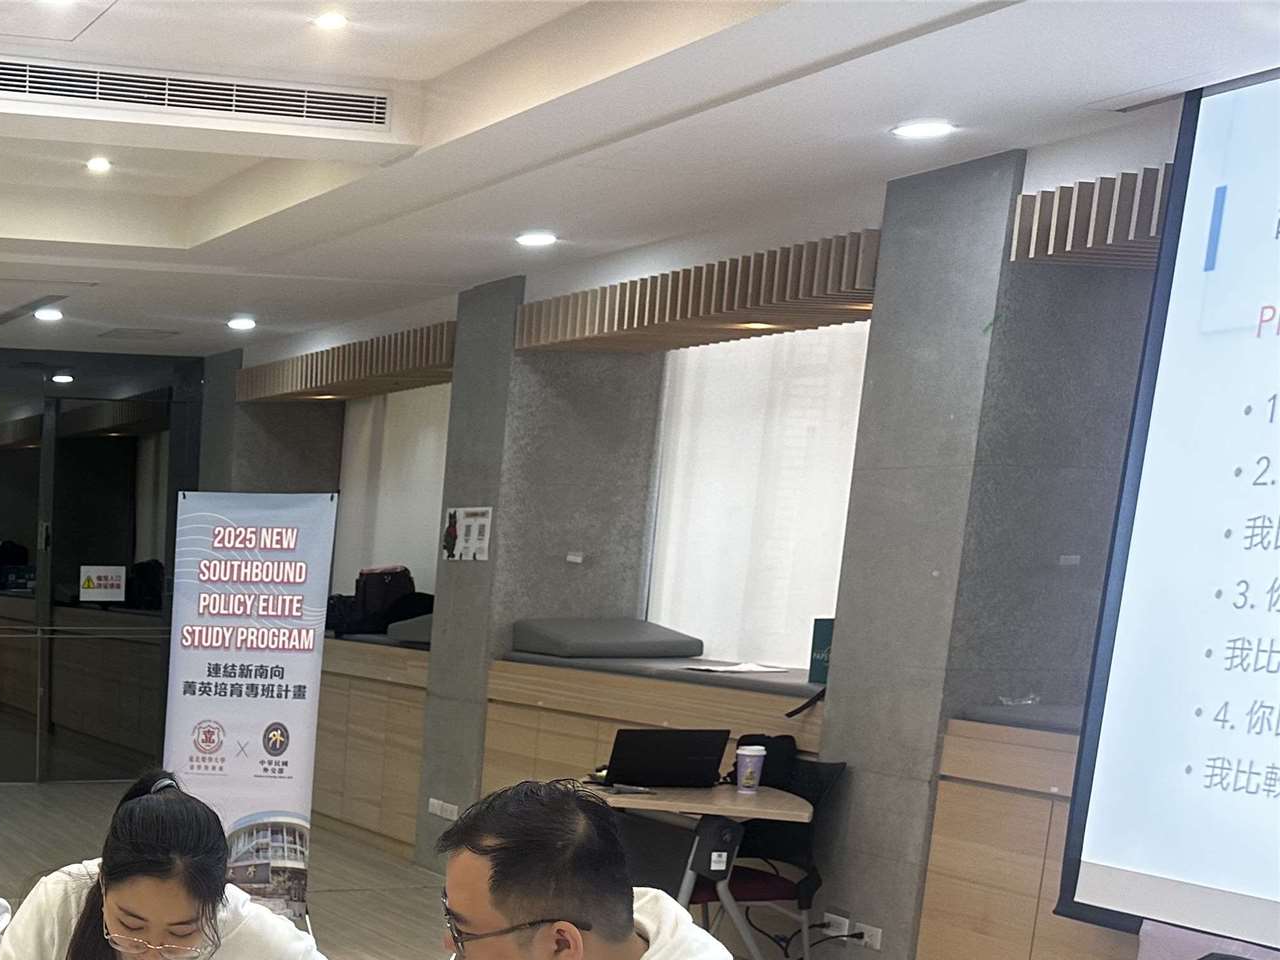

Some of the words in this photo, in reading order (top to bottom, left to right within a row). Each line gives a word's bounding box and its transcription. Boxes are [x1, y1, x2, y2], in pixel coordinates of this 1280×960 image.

[1256, 304, 1280, 338] P
[212, 527, 256, 549] 2025
[259, 527, 297, 549] NEW
[1243, 514, 1280, 551] 我
[198, 560, 306, 584] SOUTHBOUND
[198, 593, 255, 616] POLICY
[258, 595, 303, 617] ELITE
[181, 626, 234, 649] STUDY
[236, 626, 315, 650] PROGRAM
[206, 662, 285, 681] 連結新南向
[182, 681, 307, 700] 菁英培育專班計畫
